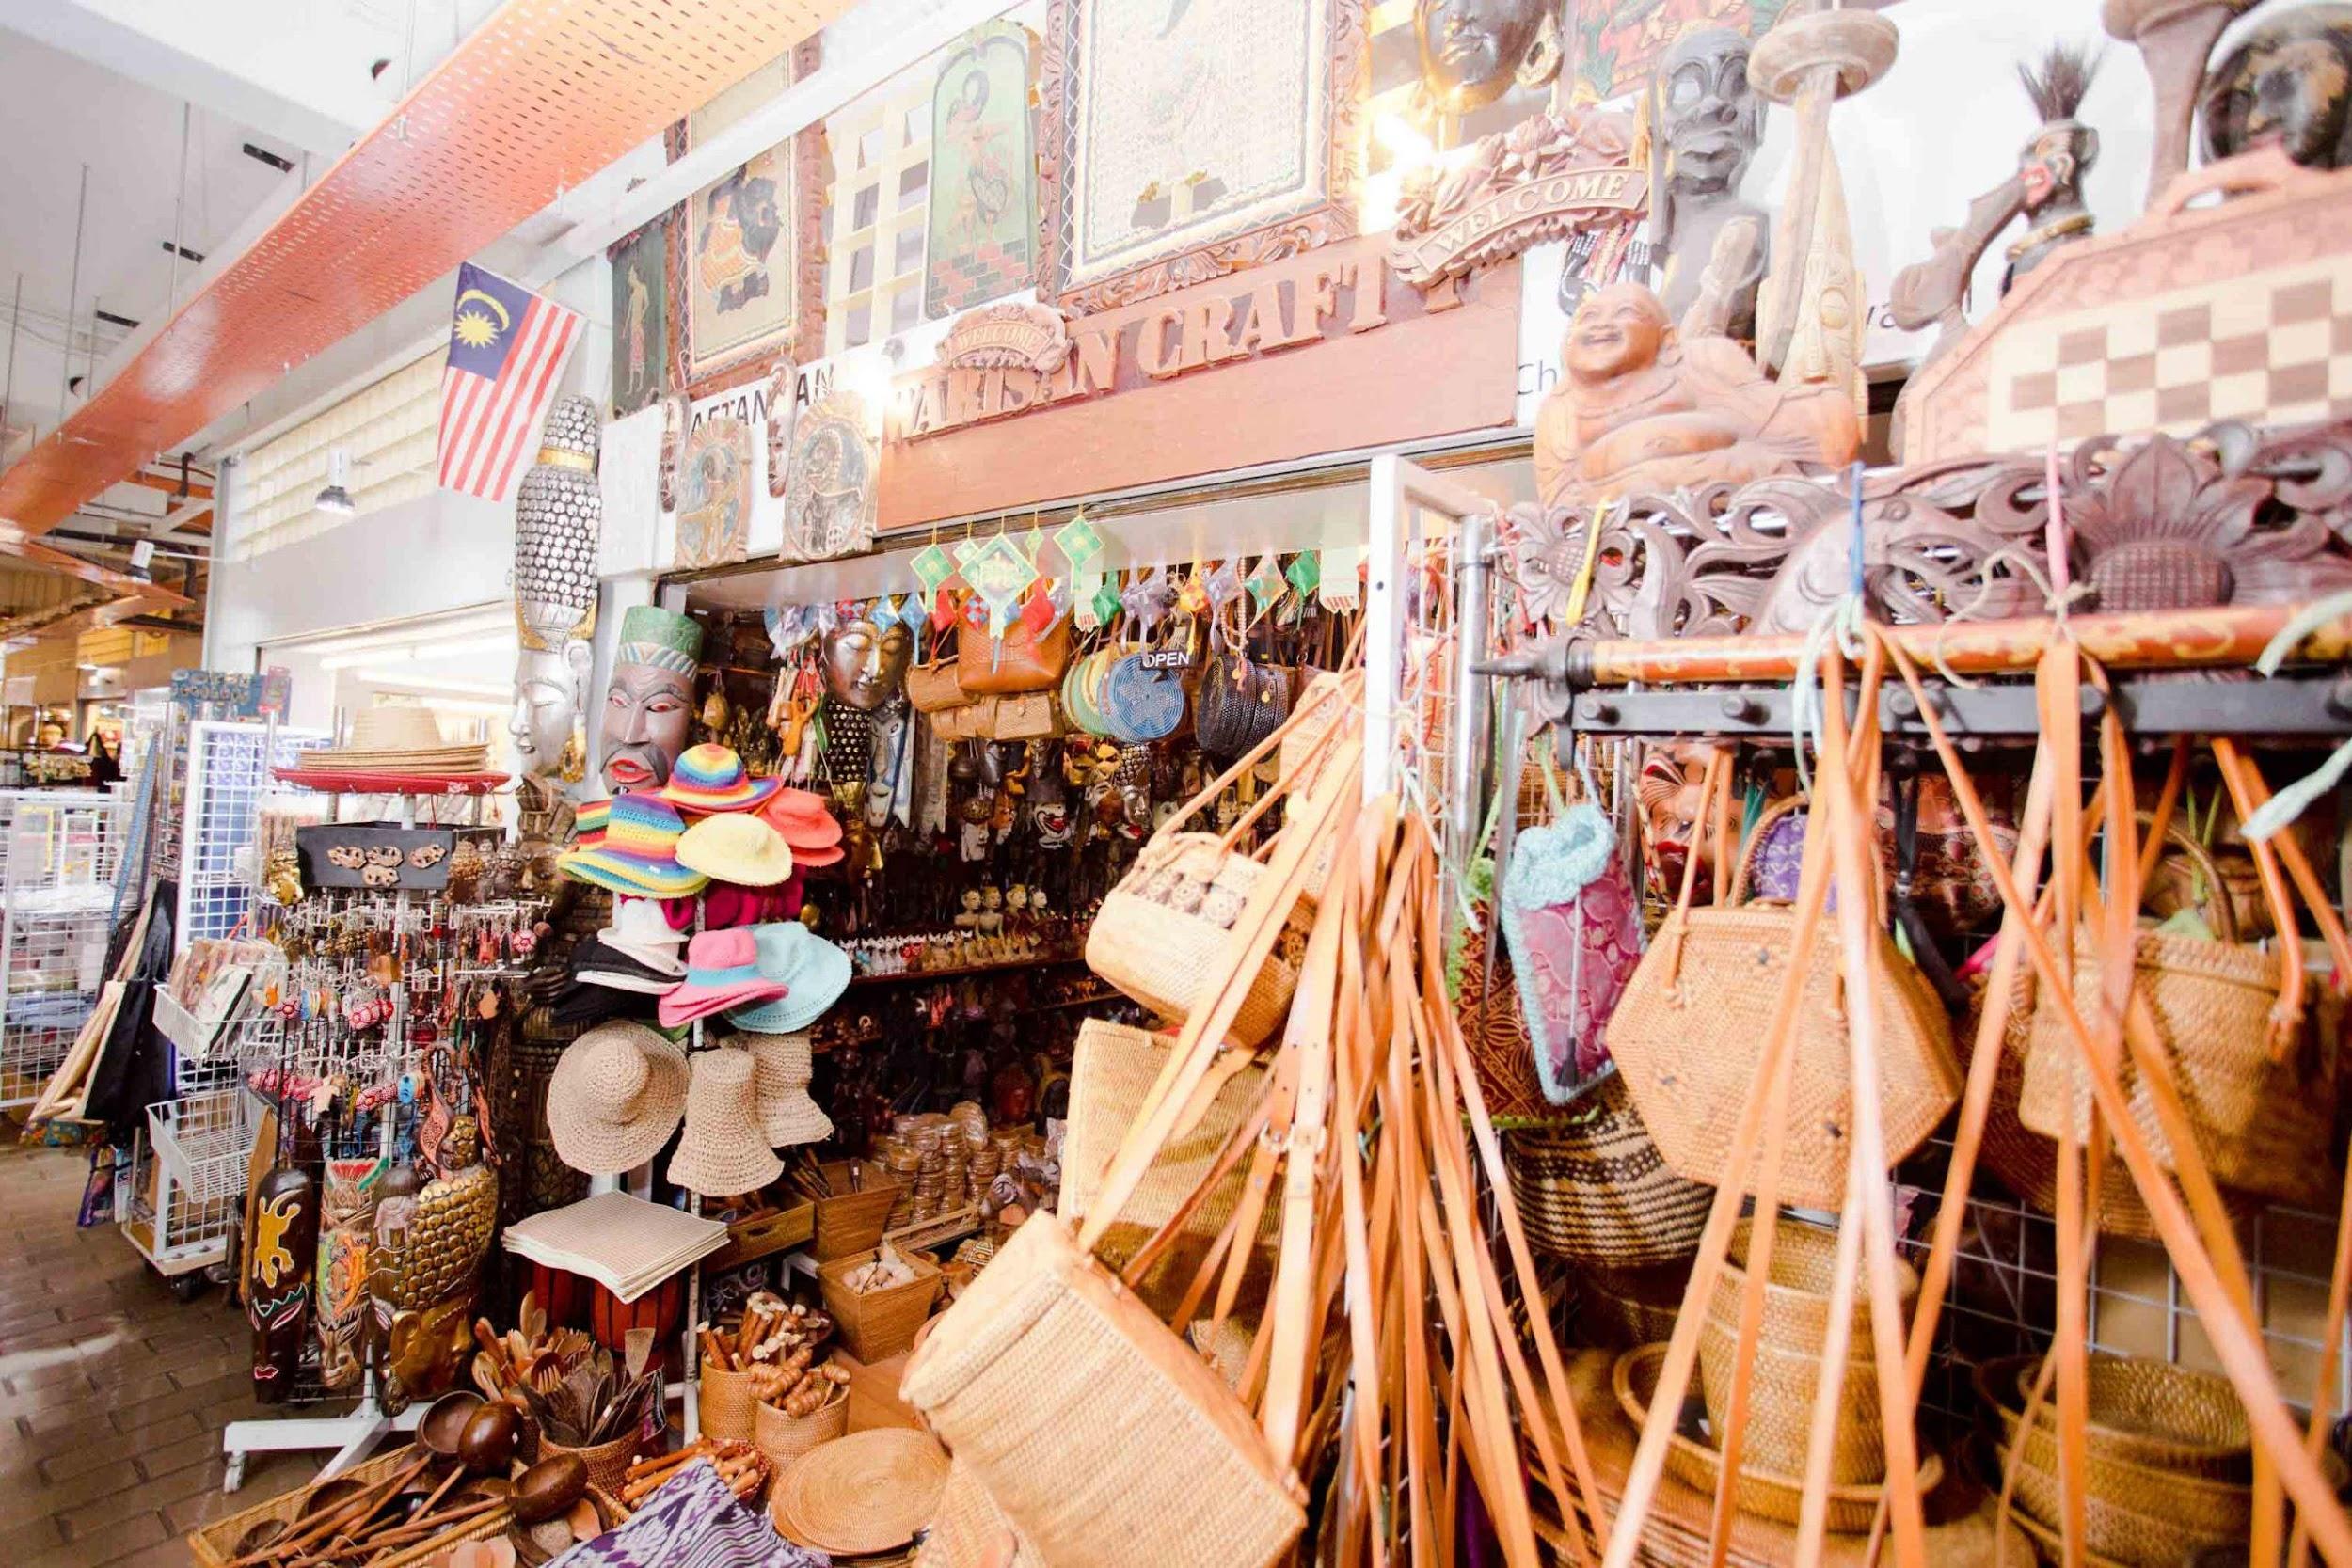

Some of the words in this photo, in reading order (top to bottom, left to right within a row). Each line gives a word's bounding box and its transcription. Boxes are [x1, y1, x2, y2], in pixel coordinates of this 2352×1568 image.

[1434, 172, 1629, 252] WELCOME
[957, 325, 1041, 351] WELCOME
[1142, 651, 1190, 668] OPEN
